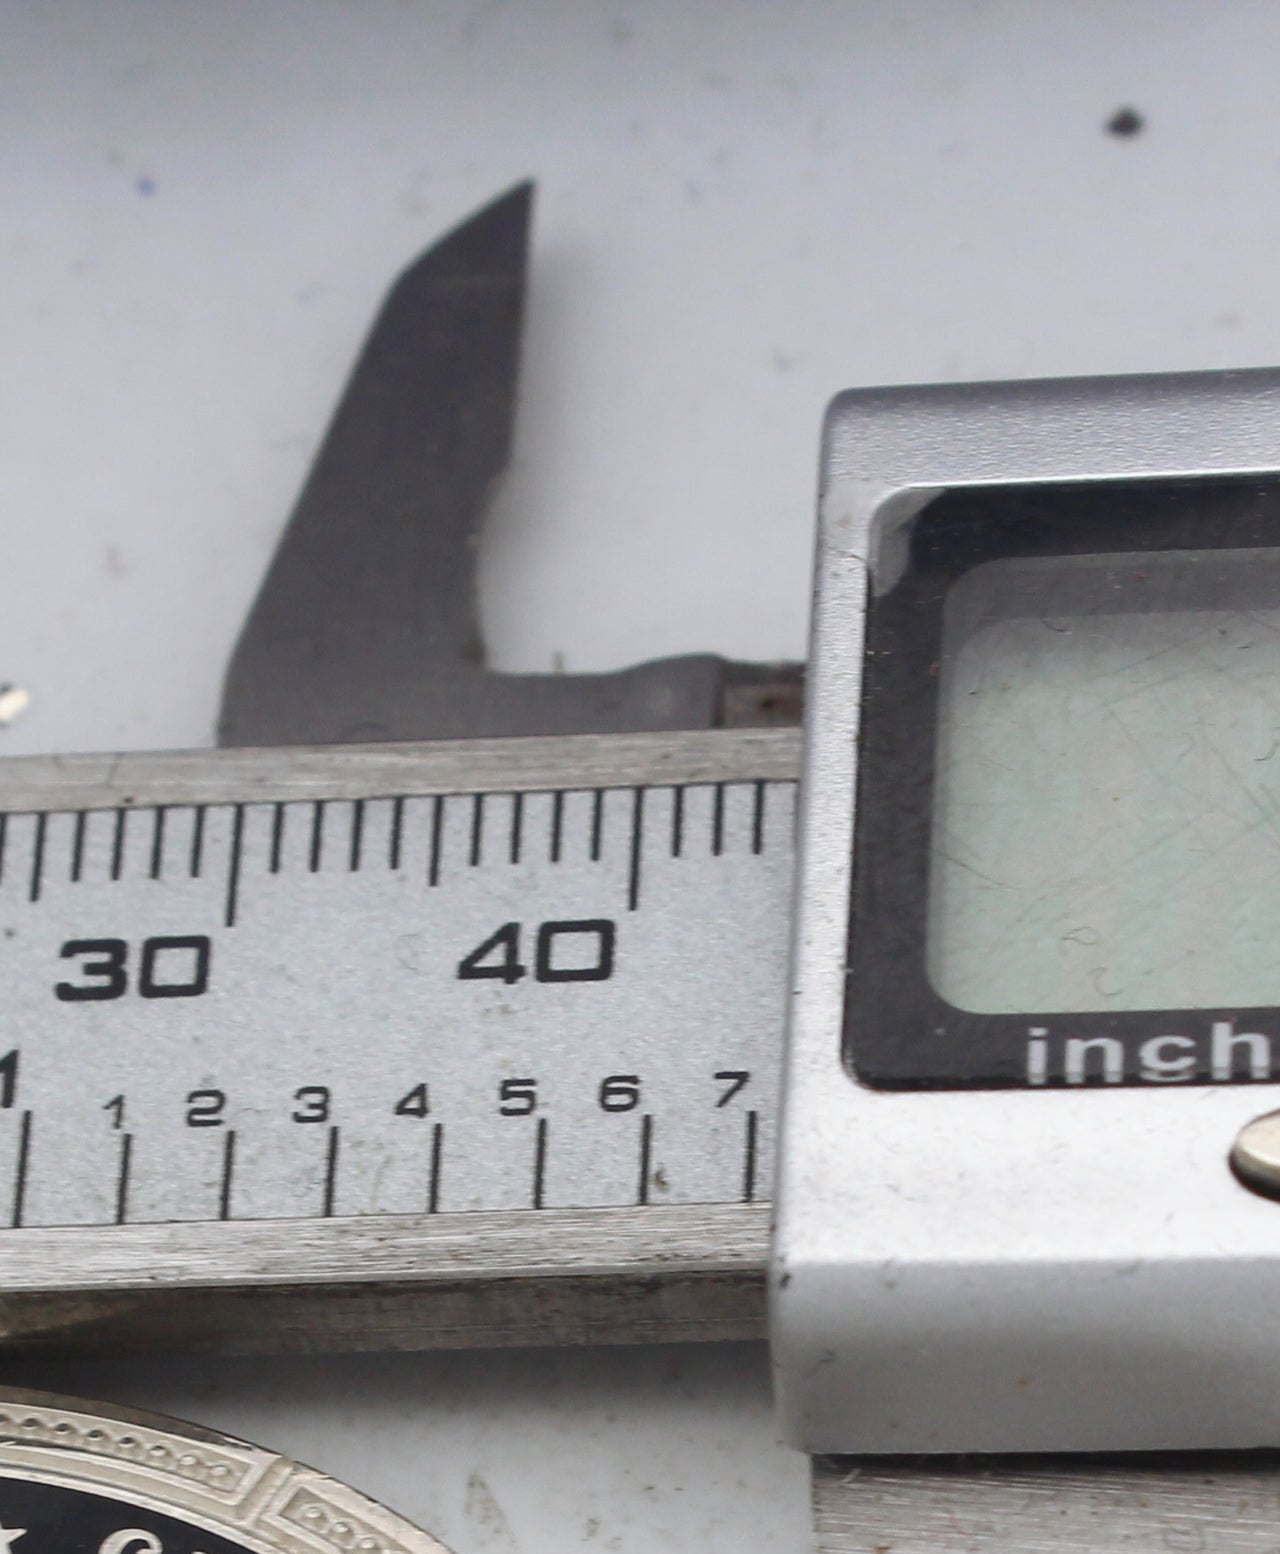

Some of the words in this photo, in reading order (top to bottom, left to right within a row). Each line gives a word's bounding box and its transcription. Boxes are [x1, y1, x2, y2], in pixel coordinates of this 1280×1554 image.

[54, 934, 212, 1002] 30
[456, 917, 617, 985] 40
[101, 1094, 126, 1130] 1
[185, 1088, 228, 1127] 2
[291, 1086, 333, 1124] 3
[393, 1082, 431, 1119] 4
[497, 1077, 538, 1117] 5
[597, 1073, 642, 1112] 6
[712, 1070, 752, 1108] 7
